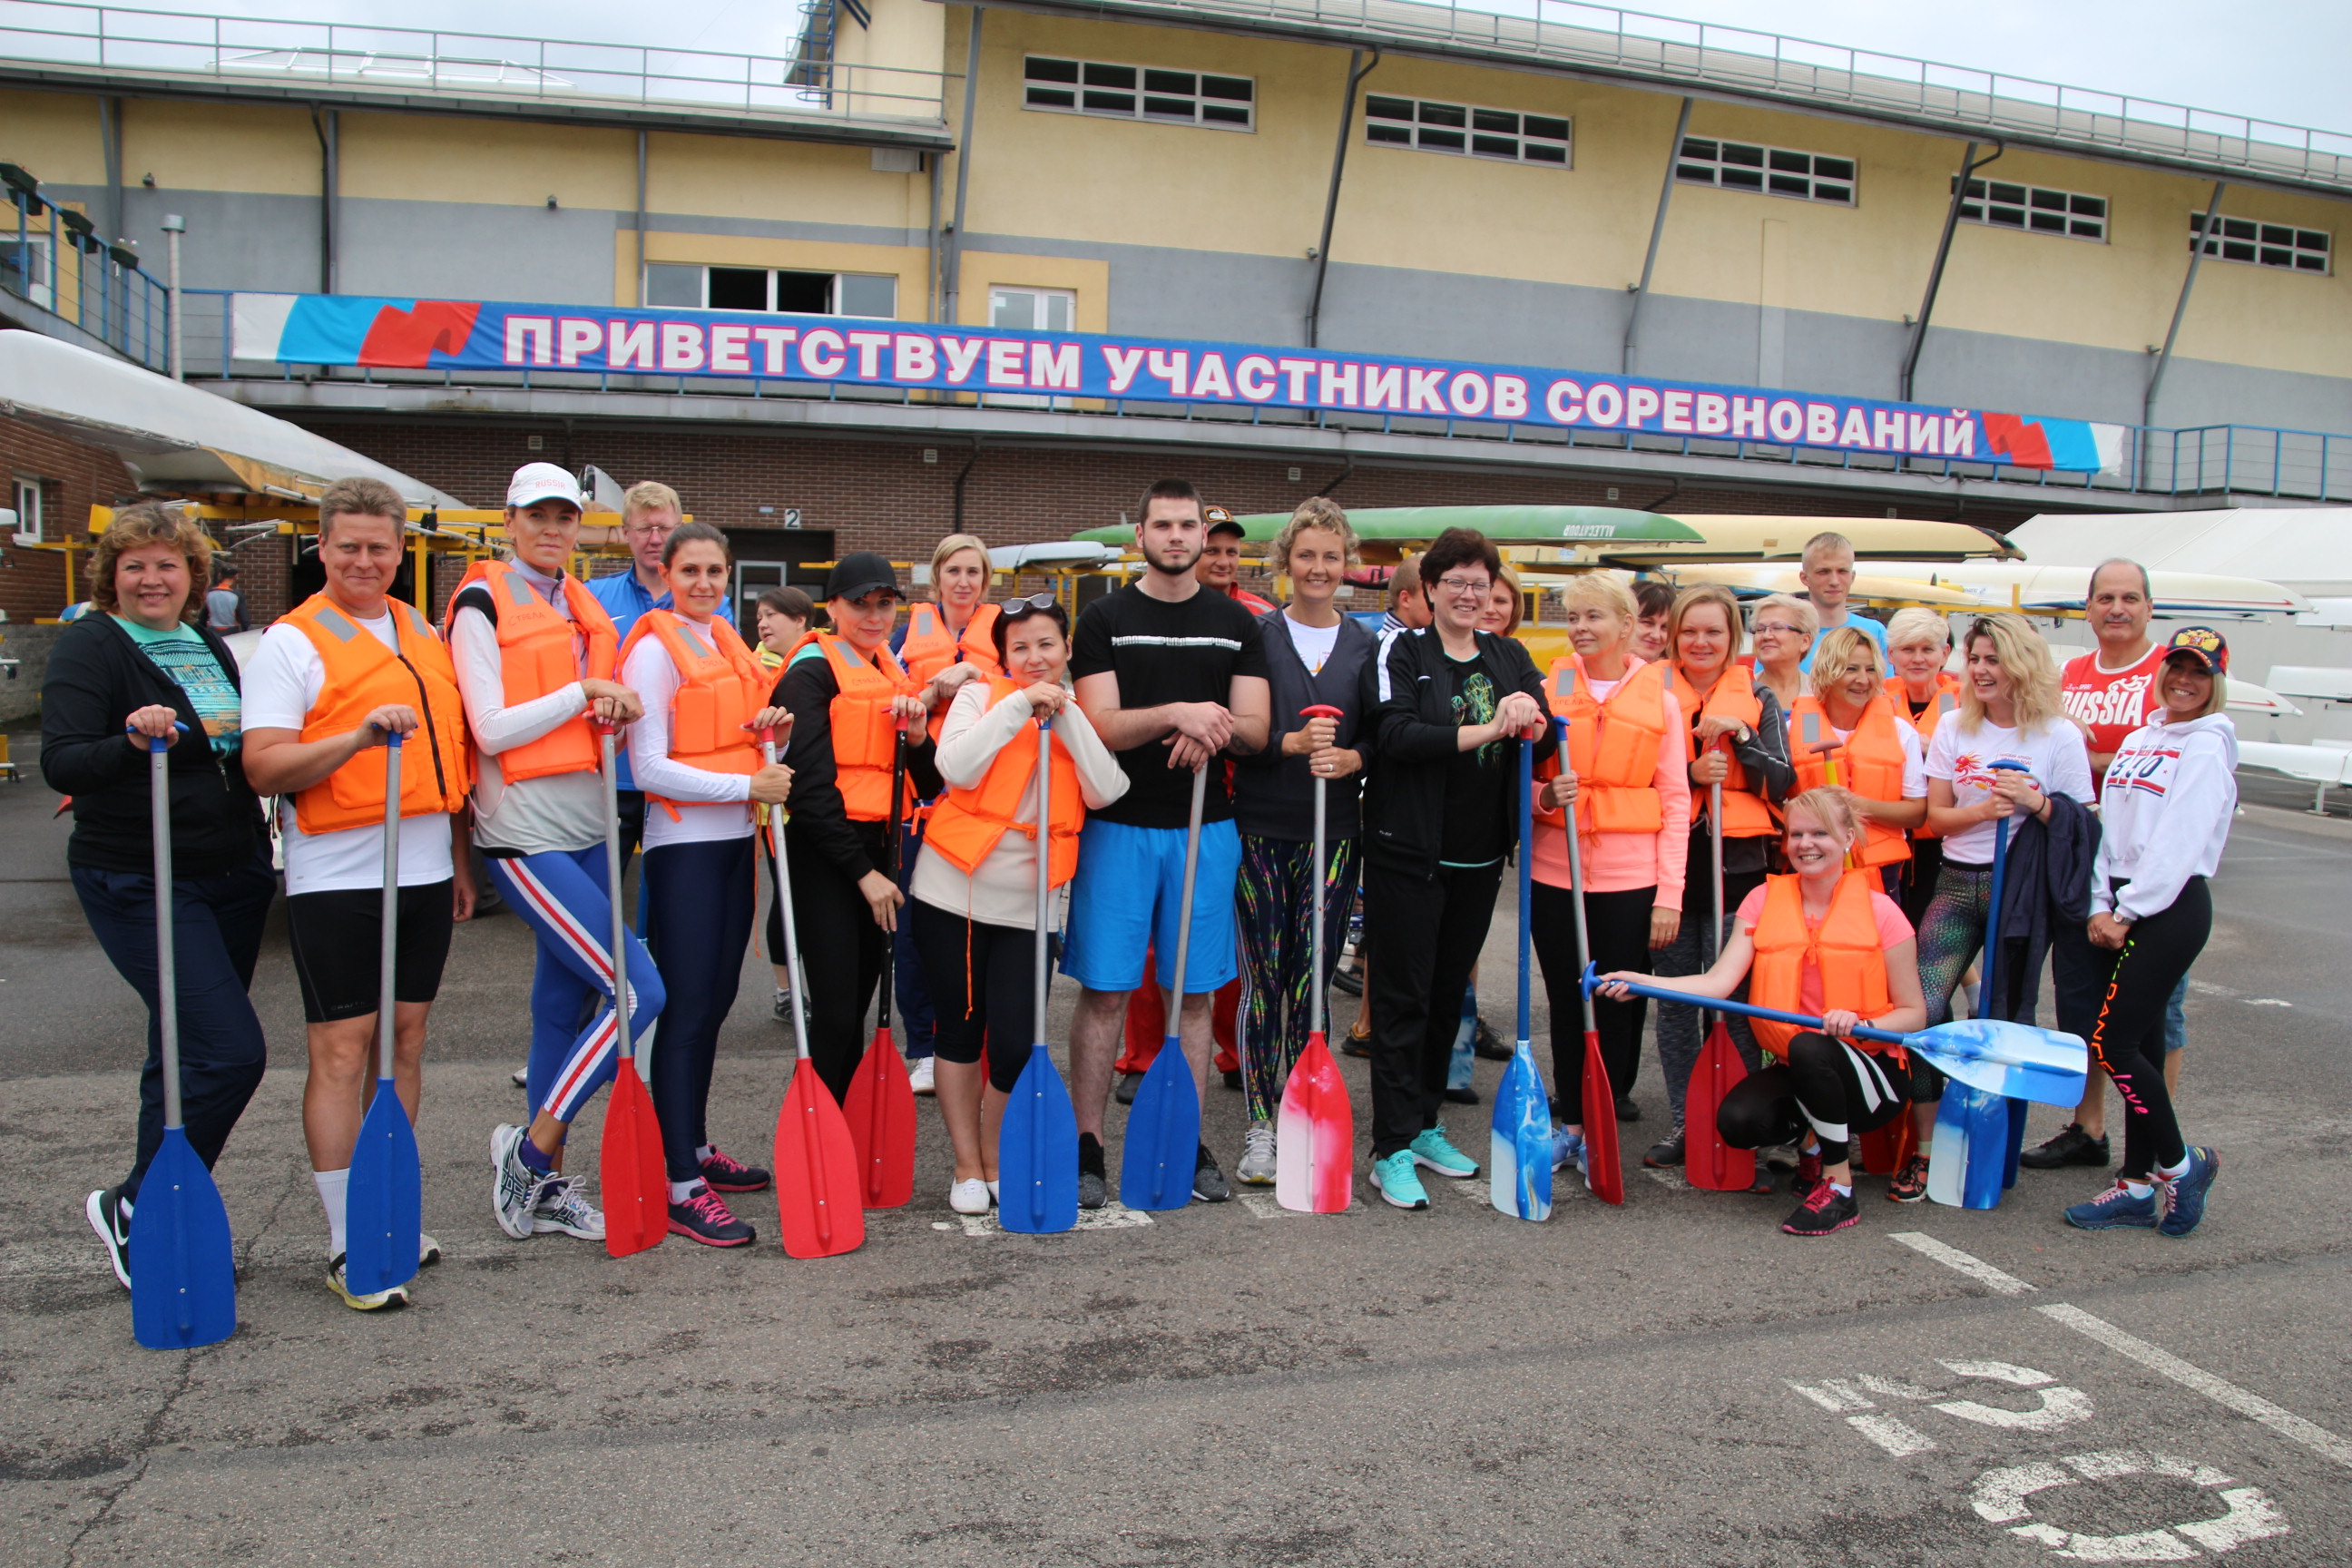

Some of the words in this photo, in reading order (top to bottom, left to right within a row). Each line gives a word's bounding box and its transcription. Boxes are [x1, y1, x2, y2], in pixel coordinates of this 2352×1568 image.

[503, 314, 1082, 391] ПРИВЕТСТВУЕМ
[1100, 345, 1530, 418] УЧАСТНИКОВ
[1546, 378, 1975, 457] СОРЕВНОВАНИЙ
[787, 509, 799, 527] 2
[508, 612, 546, 626] СТРЕЛА
[2063, 690, 2145, 727] RUSSIA
[2112, 1074, 2150, 1115] love
